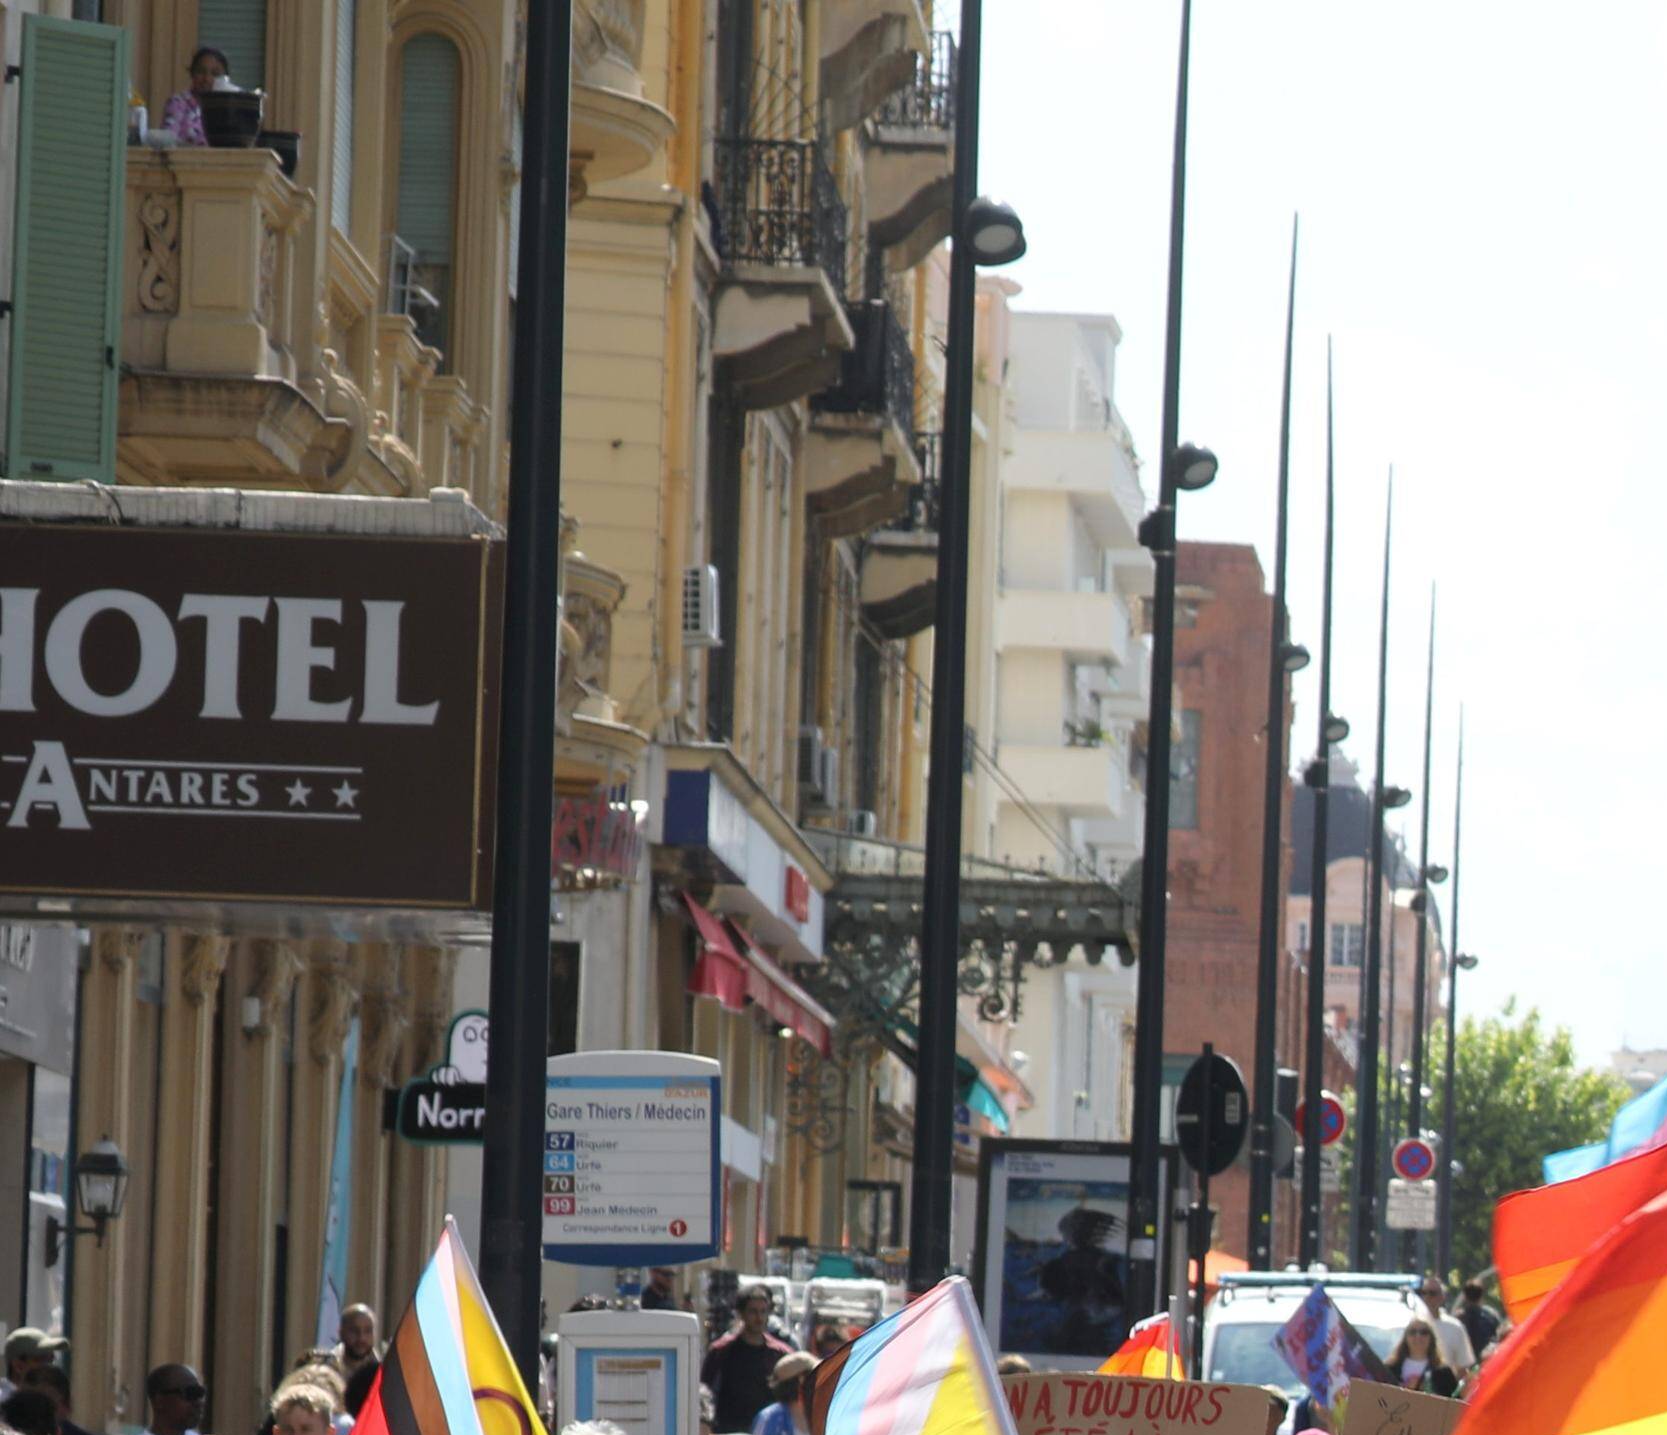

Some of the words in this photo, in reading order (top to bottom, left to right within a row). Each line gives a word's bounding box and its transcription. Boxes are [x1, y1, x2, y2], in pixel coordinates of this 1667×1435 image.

[6, 741, 260, 830] ANTARES
[546, 1102, 582, 1120] Gare
[587, 1102, 632, 1120] Thiers
[550, 1134, 571, 1148] 57
[550, 1155, 569, 1168] 64
[550, 1178, 569, 1192] 70
[550, 1199, 571, 1213] 99
[576, 1205, 604, 1215] Jean
[1062, 1379, 1231, 1426] TOUJOURS
